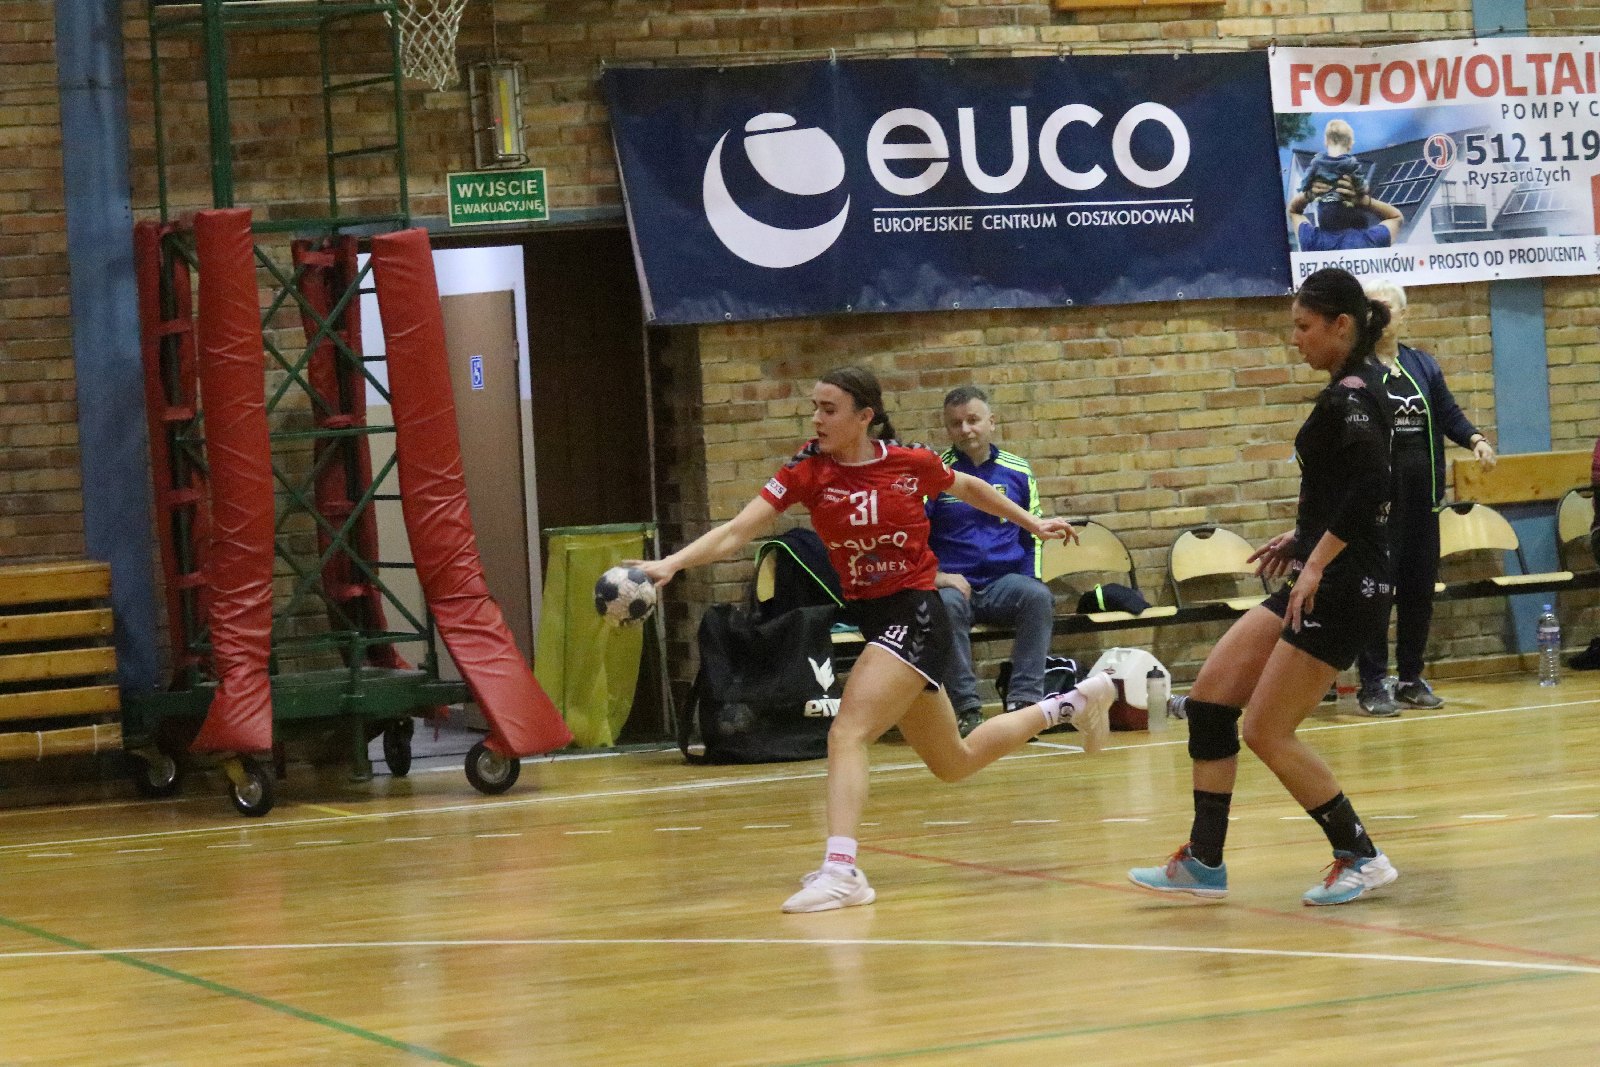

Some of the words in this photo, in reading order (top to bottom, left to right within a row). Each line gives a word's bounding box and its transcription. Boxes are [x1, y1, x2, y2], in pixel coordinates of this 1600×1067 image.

[1290, 52, 1600, 106] FOTOWOLTAI
[1501, 101, 1579, 119] POMPY
[1466, 132, 1529, 165] 512
[1539, 130, 1600, 161] 119
[456, 178, 538, 198] WYJŚCIE
[454, 199, 542, 215] EWAKUACYJNE
[873, 215, 973, 233] EUROPEJSKIE
[982, 212, 1057, 230] CENTRUM
[1066, 203, 1194, 227] ODSZKODOWAŃ
[1429, 251, 1479, 270] PROSTO
[1484, 250, 1504, 267] OD
[1509, 246, 1587, 265] PRODUCENTA
[849, 490, 878, 526] 31
[885, 625, 909, 642] 31
